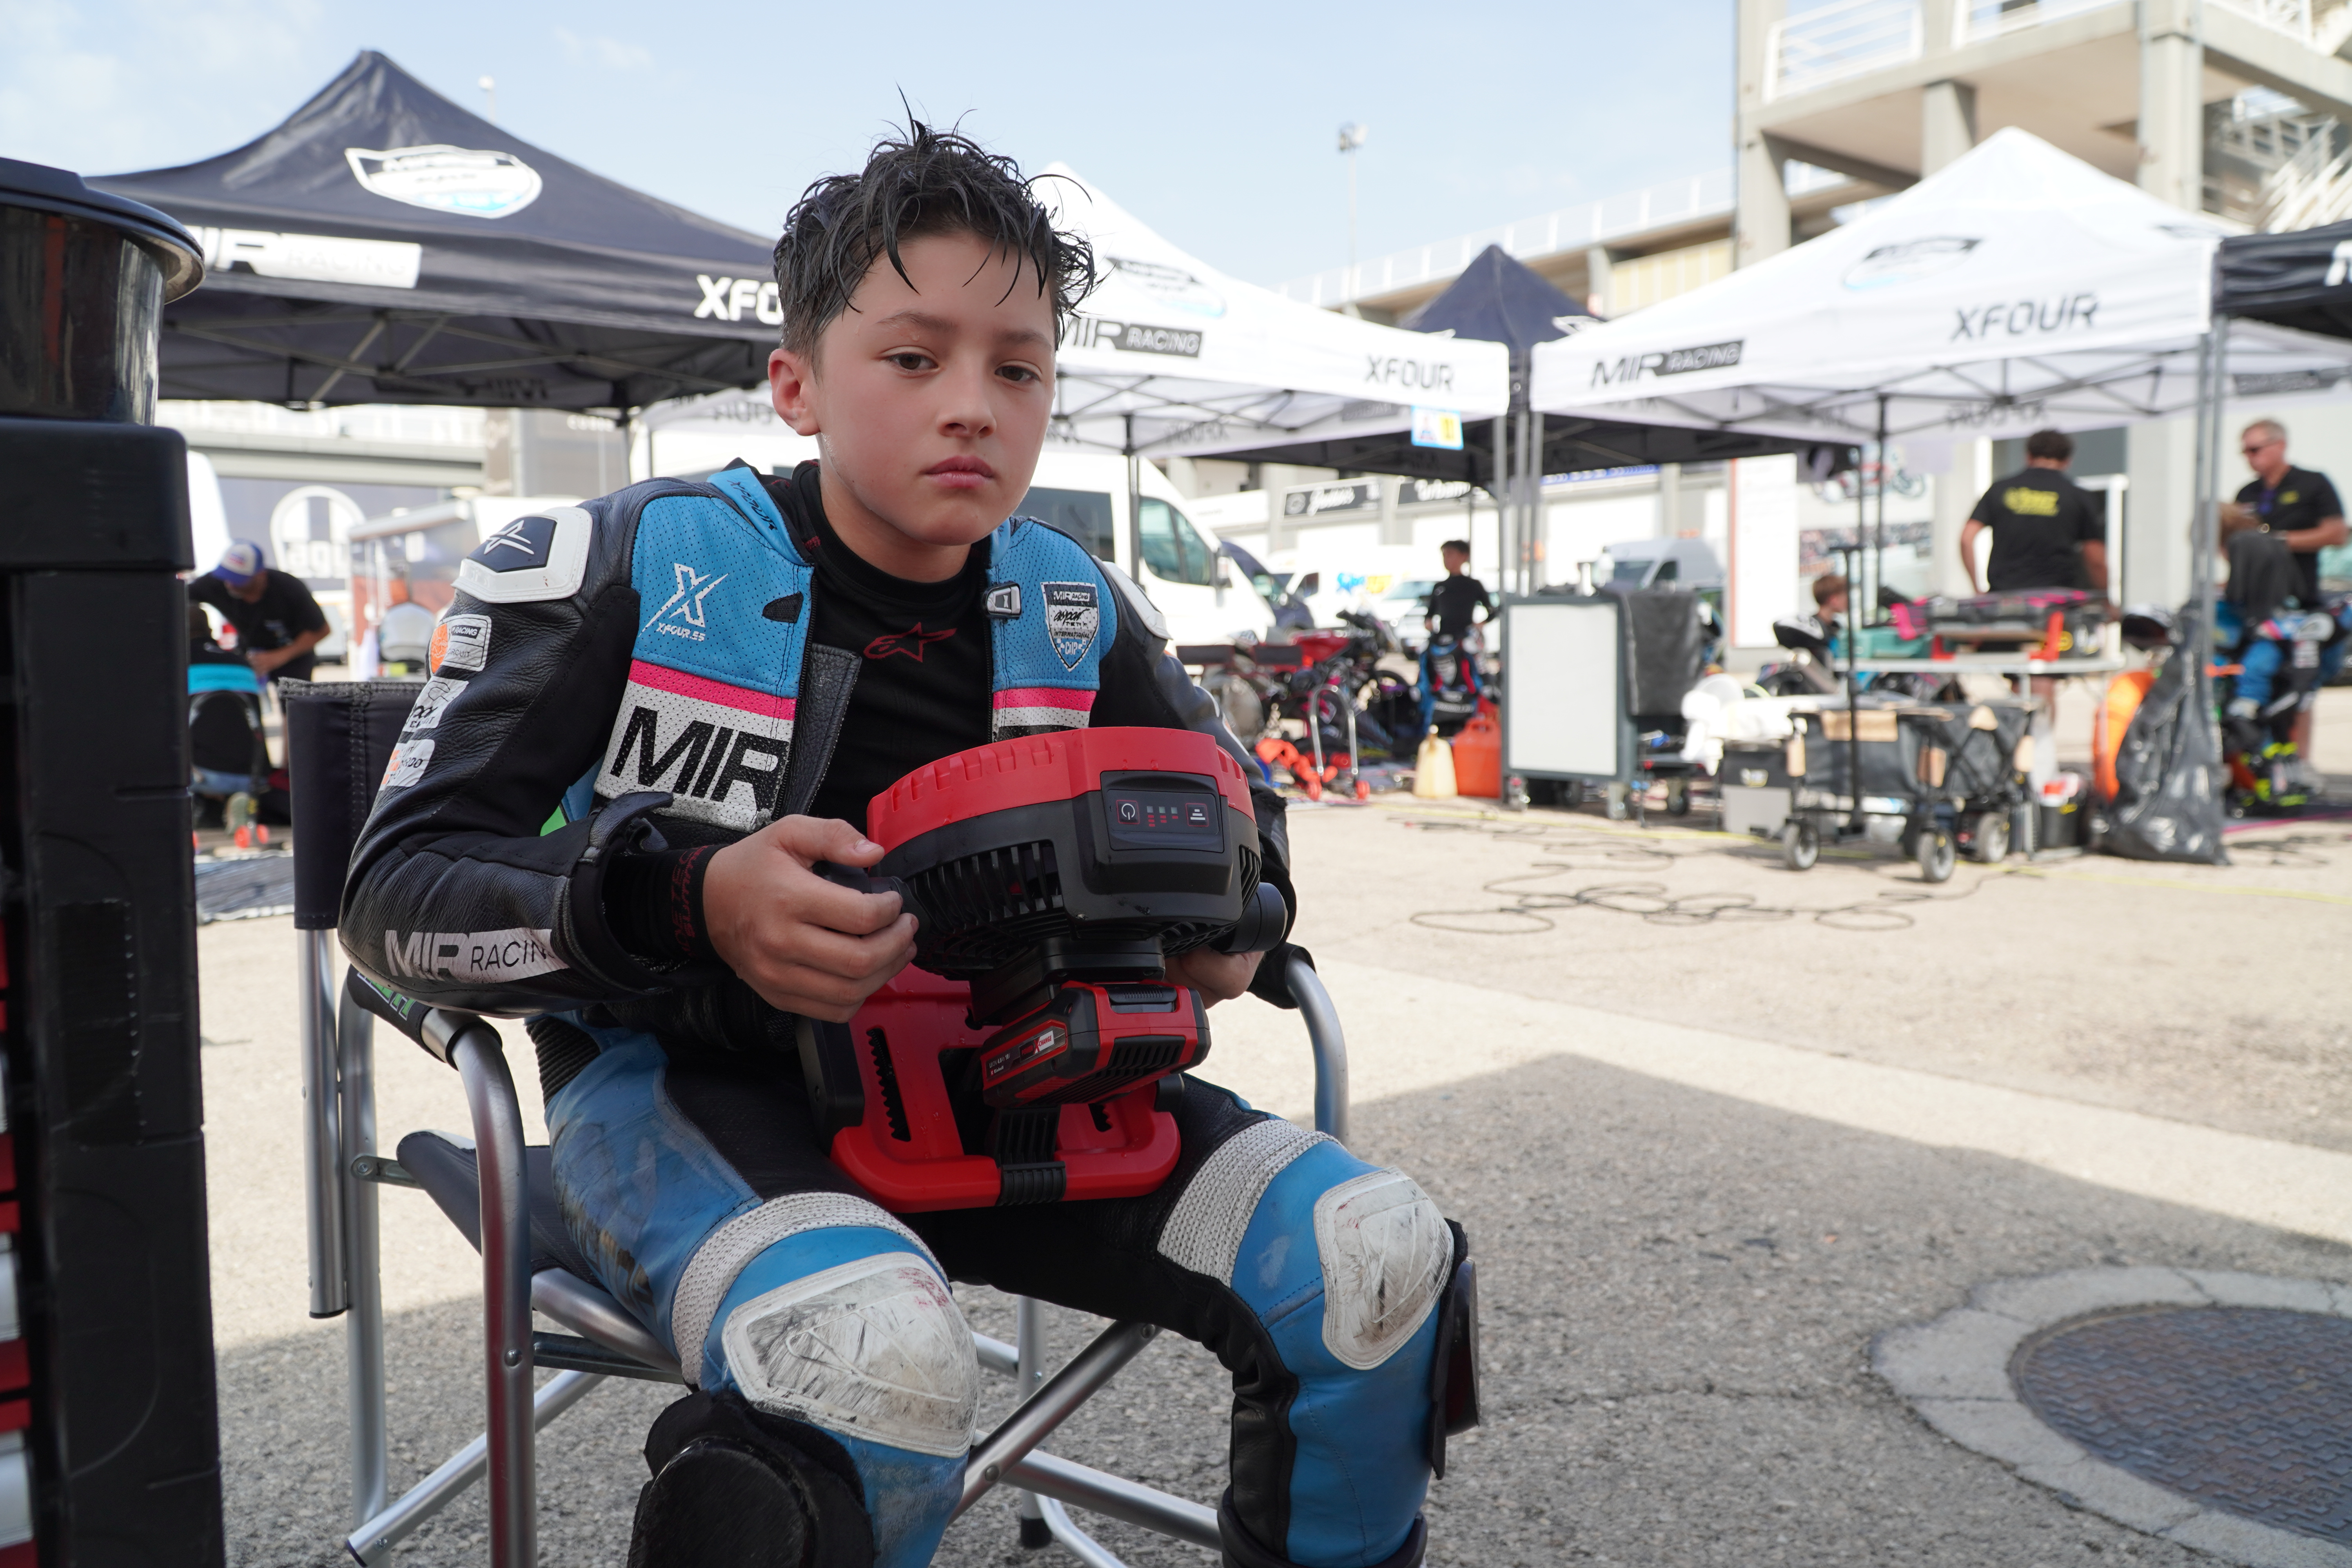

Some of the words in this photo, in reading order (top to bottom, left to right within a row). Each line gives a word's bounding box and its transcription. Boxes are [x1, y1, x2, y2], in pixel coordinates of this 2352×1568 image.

[1950, 293, 2099, 342] XFOUR
[1126, 327, 1200, 354] RACING
[1363, 354, 1455, 391] XFOUR
[1592, 351, 1665, 388] MIR
[1666, 343, 1741, 373] RACING
[1053, 591, 1072, 601] MIR
[454, 626, 478, 636] RACING
[1065, 641, 1078, 655] CUP
[610, 705, 790, 814] MIR
[385, 929, 468, 983] MIR
